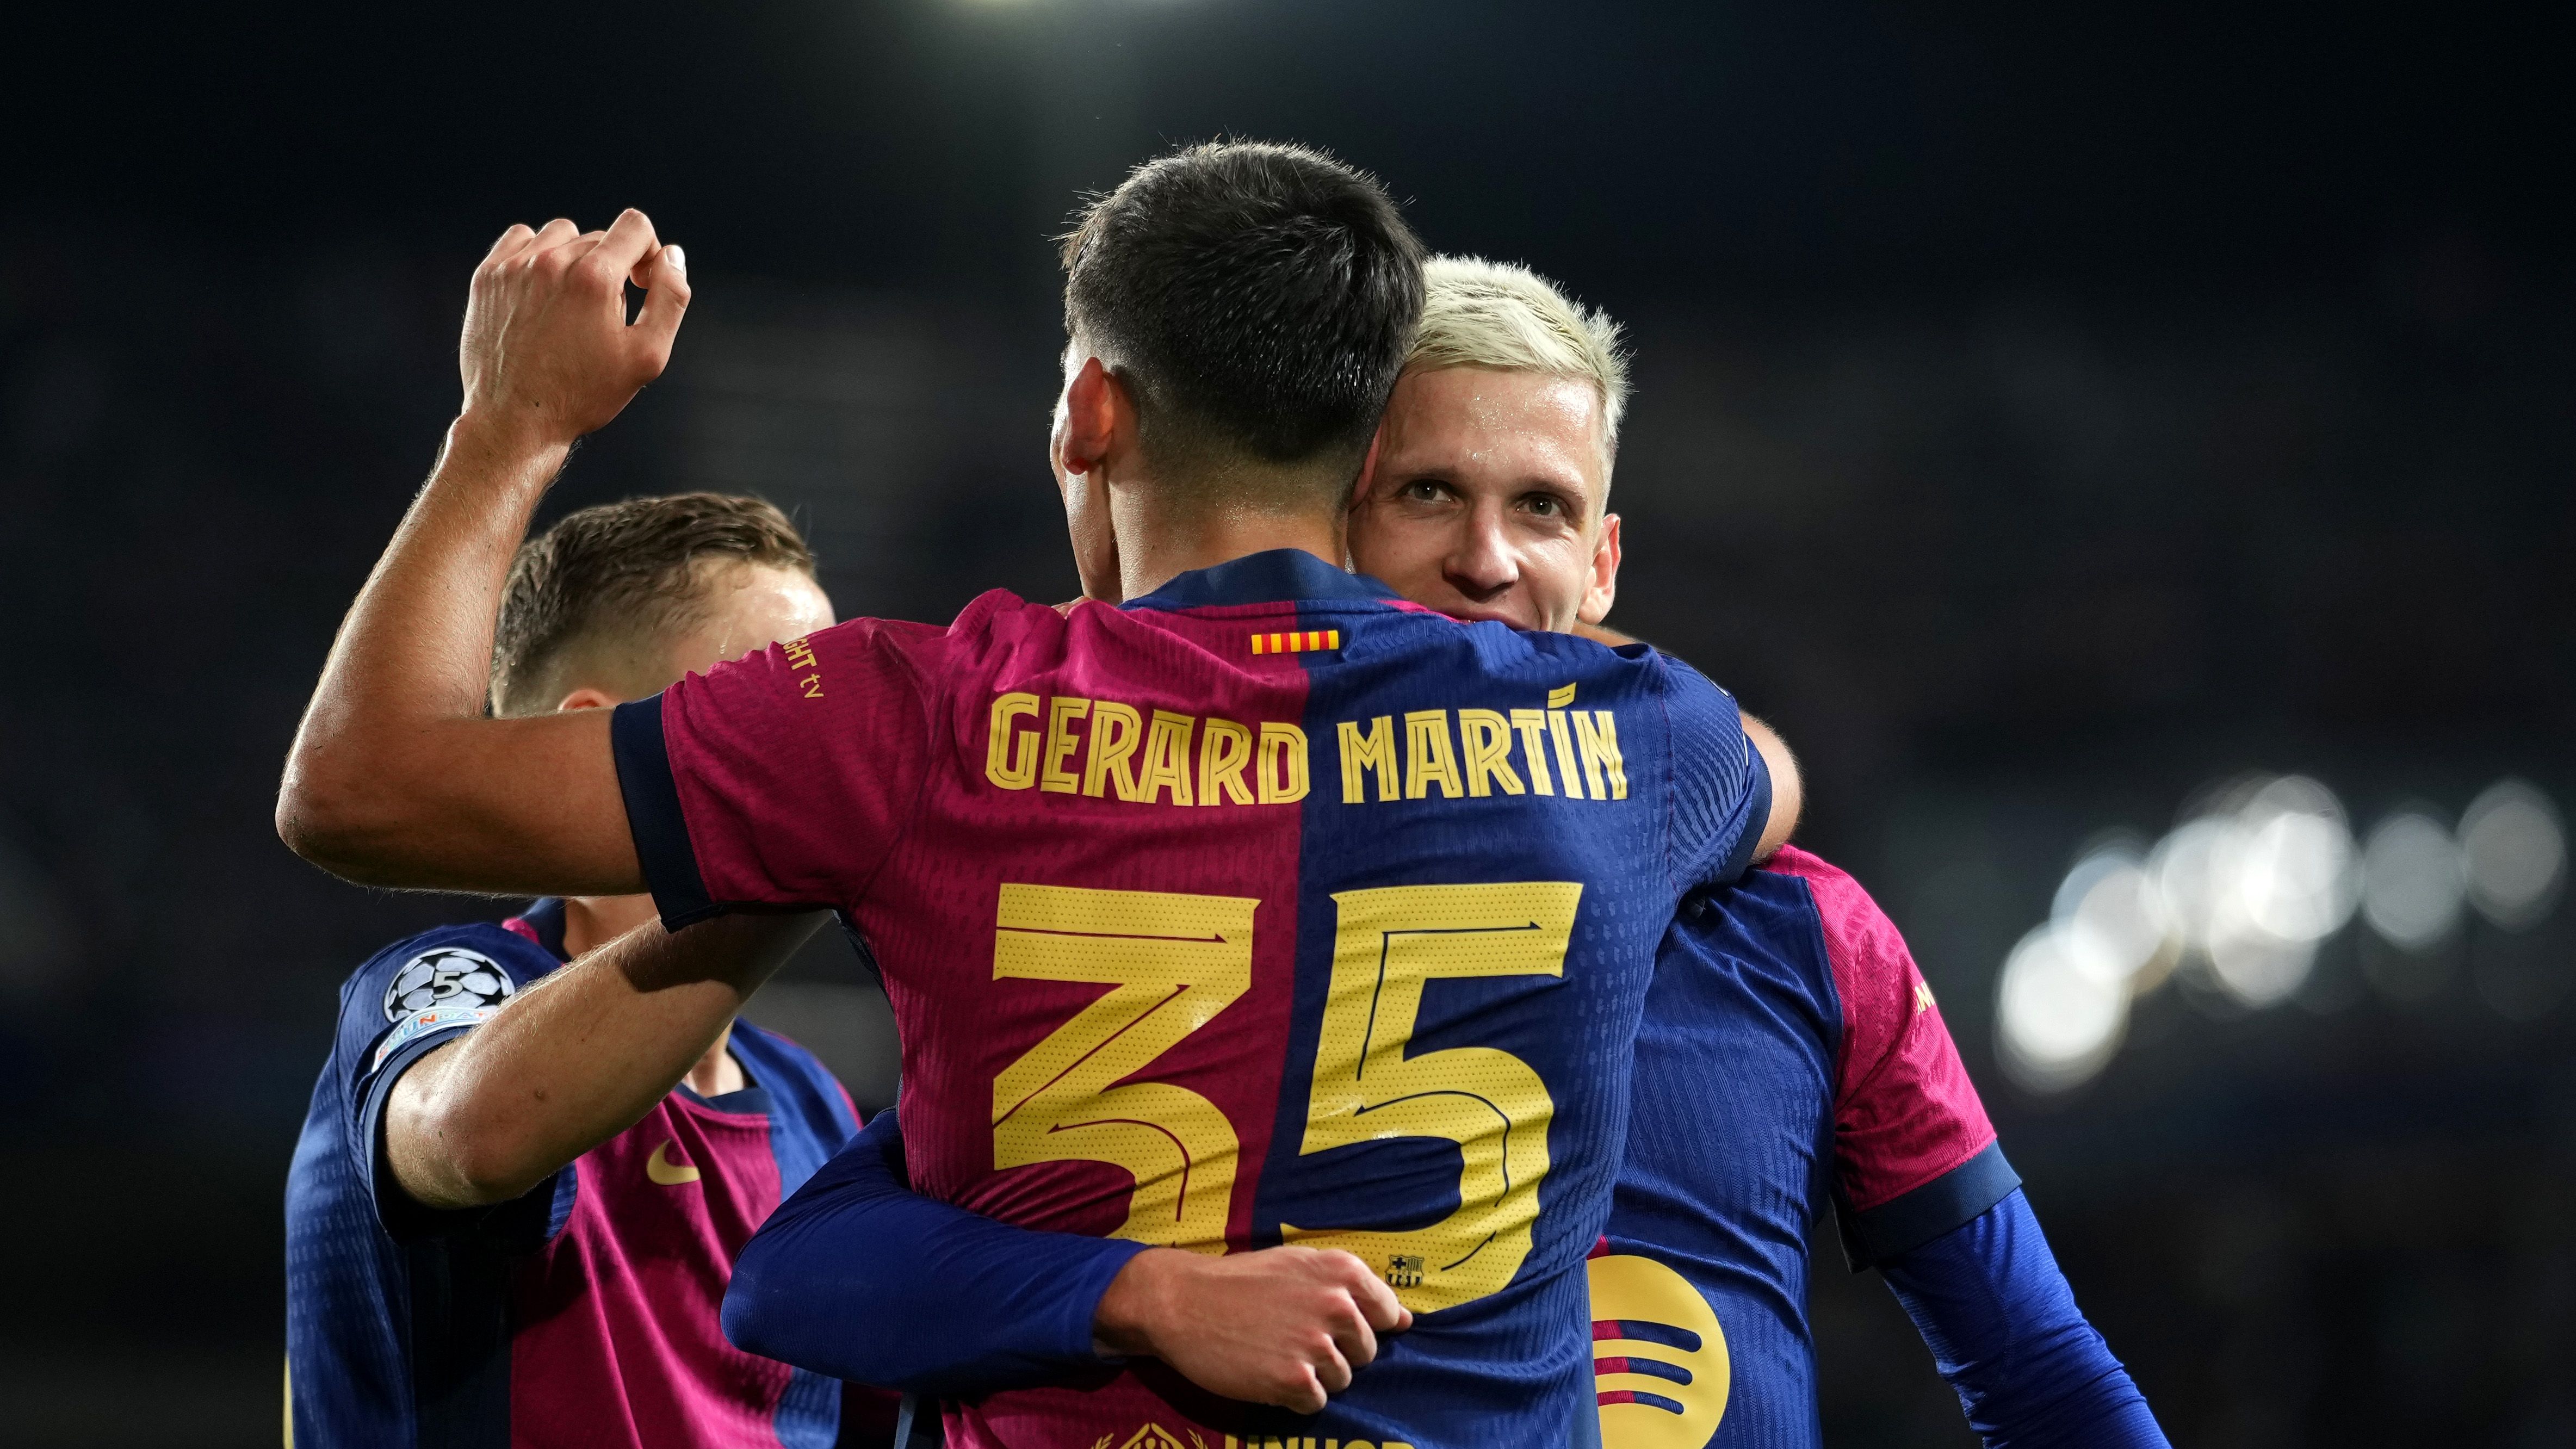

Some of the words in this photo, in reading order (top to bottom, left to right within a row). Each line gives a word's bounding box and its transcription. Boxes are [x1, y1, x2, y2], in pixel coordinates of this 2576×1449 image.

[800, 673, 824, 698] tv
[985, 692, 1310, 806] GERARD
[1336, 682, 1628, 804] MARTÍN
[432, 971, 463, 999] 5
[993, 882, 1583, 1314] 35
